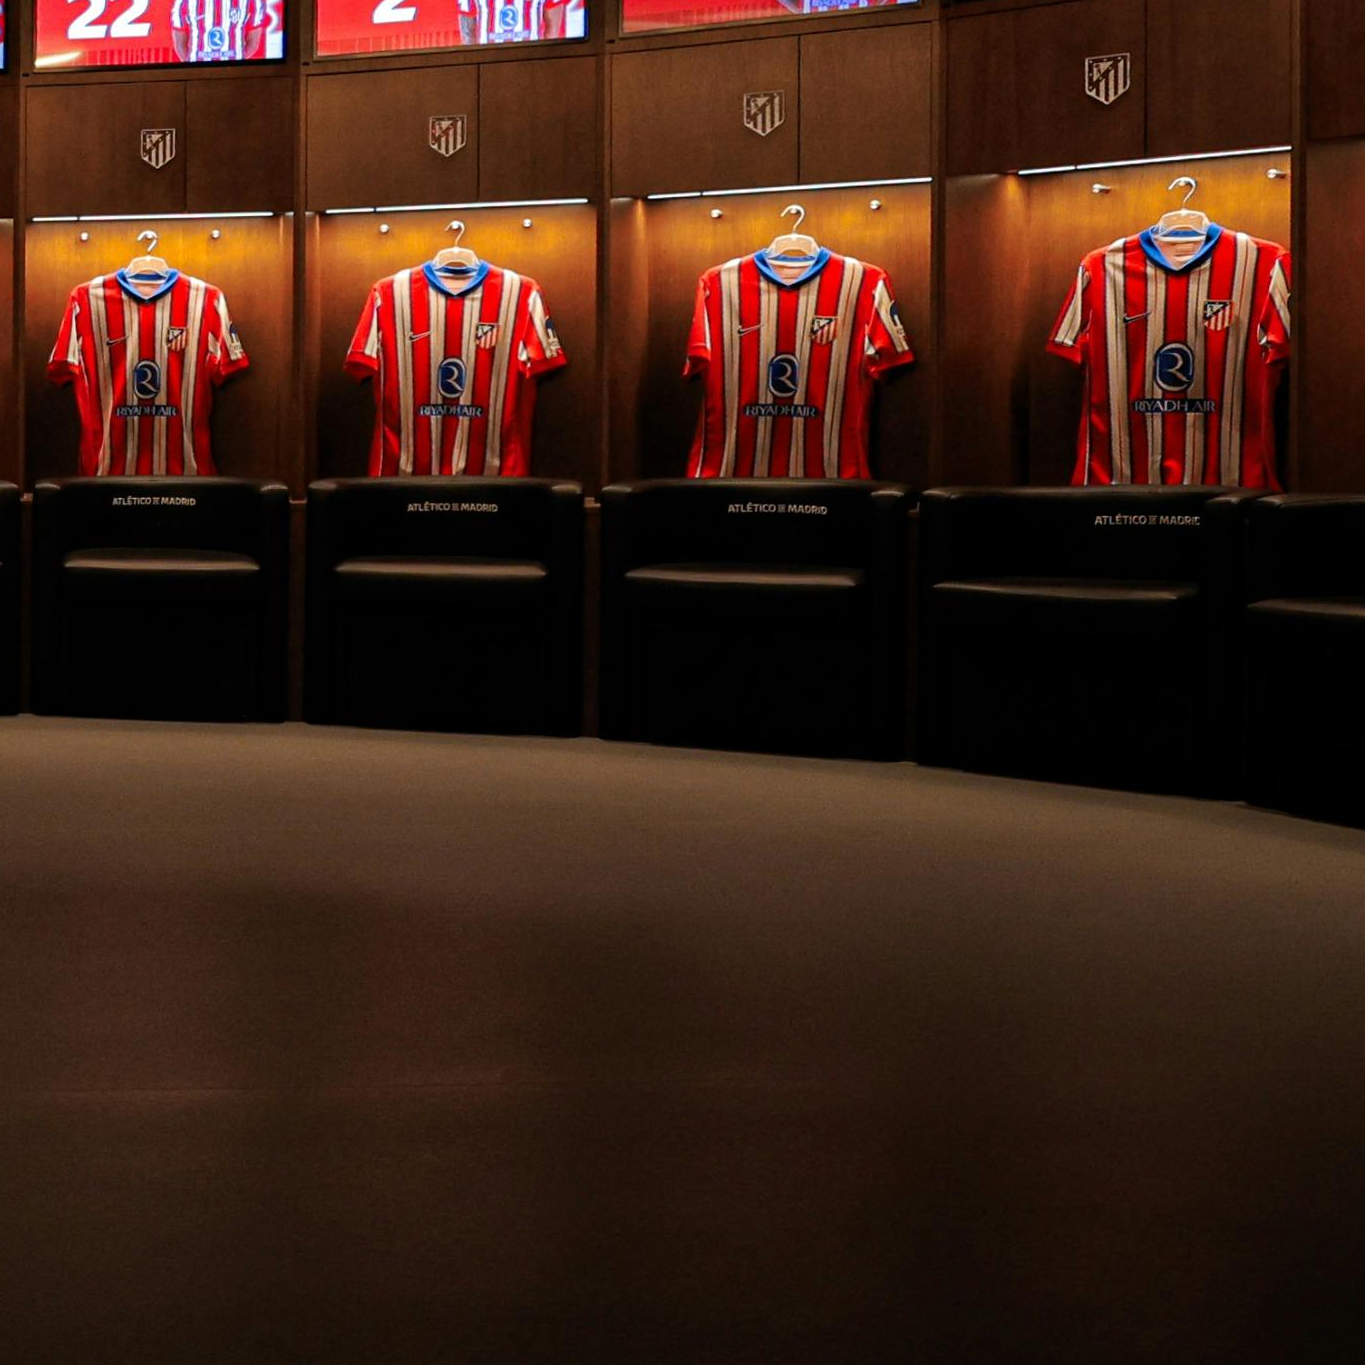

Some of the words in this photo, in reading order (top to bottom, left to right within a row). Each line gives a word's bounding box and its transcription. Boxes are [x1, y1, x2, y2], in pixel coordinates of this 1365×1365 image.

[158, 406, 177, 417] AIR
[460, 405, 482, 418] AIR
[794, 405, 817, 418] AIR
[1191, 400, 1216, 413] AIR
[112, 495, 152, 506] ATLÉTICO
[160, 496, 197, 507] MADRID
[407, 500, 451, 512] ATLÉTICO
[459, 502, 499, 513] MADRID
[727, 501, 777, 513] ATLÉTICO
[787, 504, 828, 515] MADRID
[1094, 513, 1148, 525] ATLÉTICO
